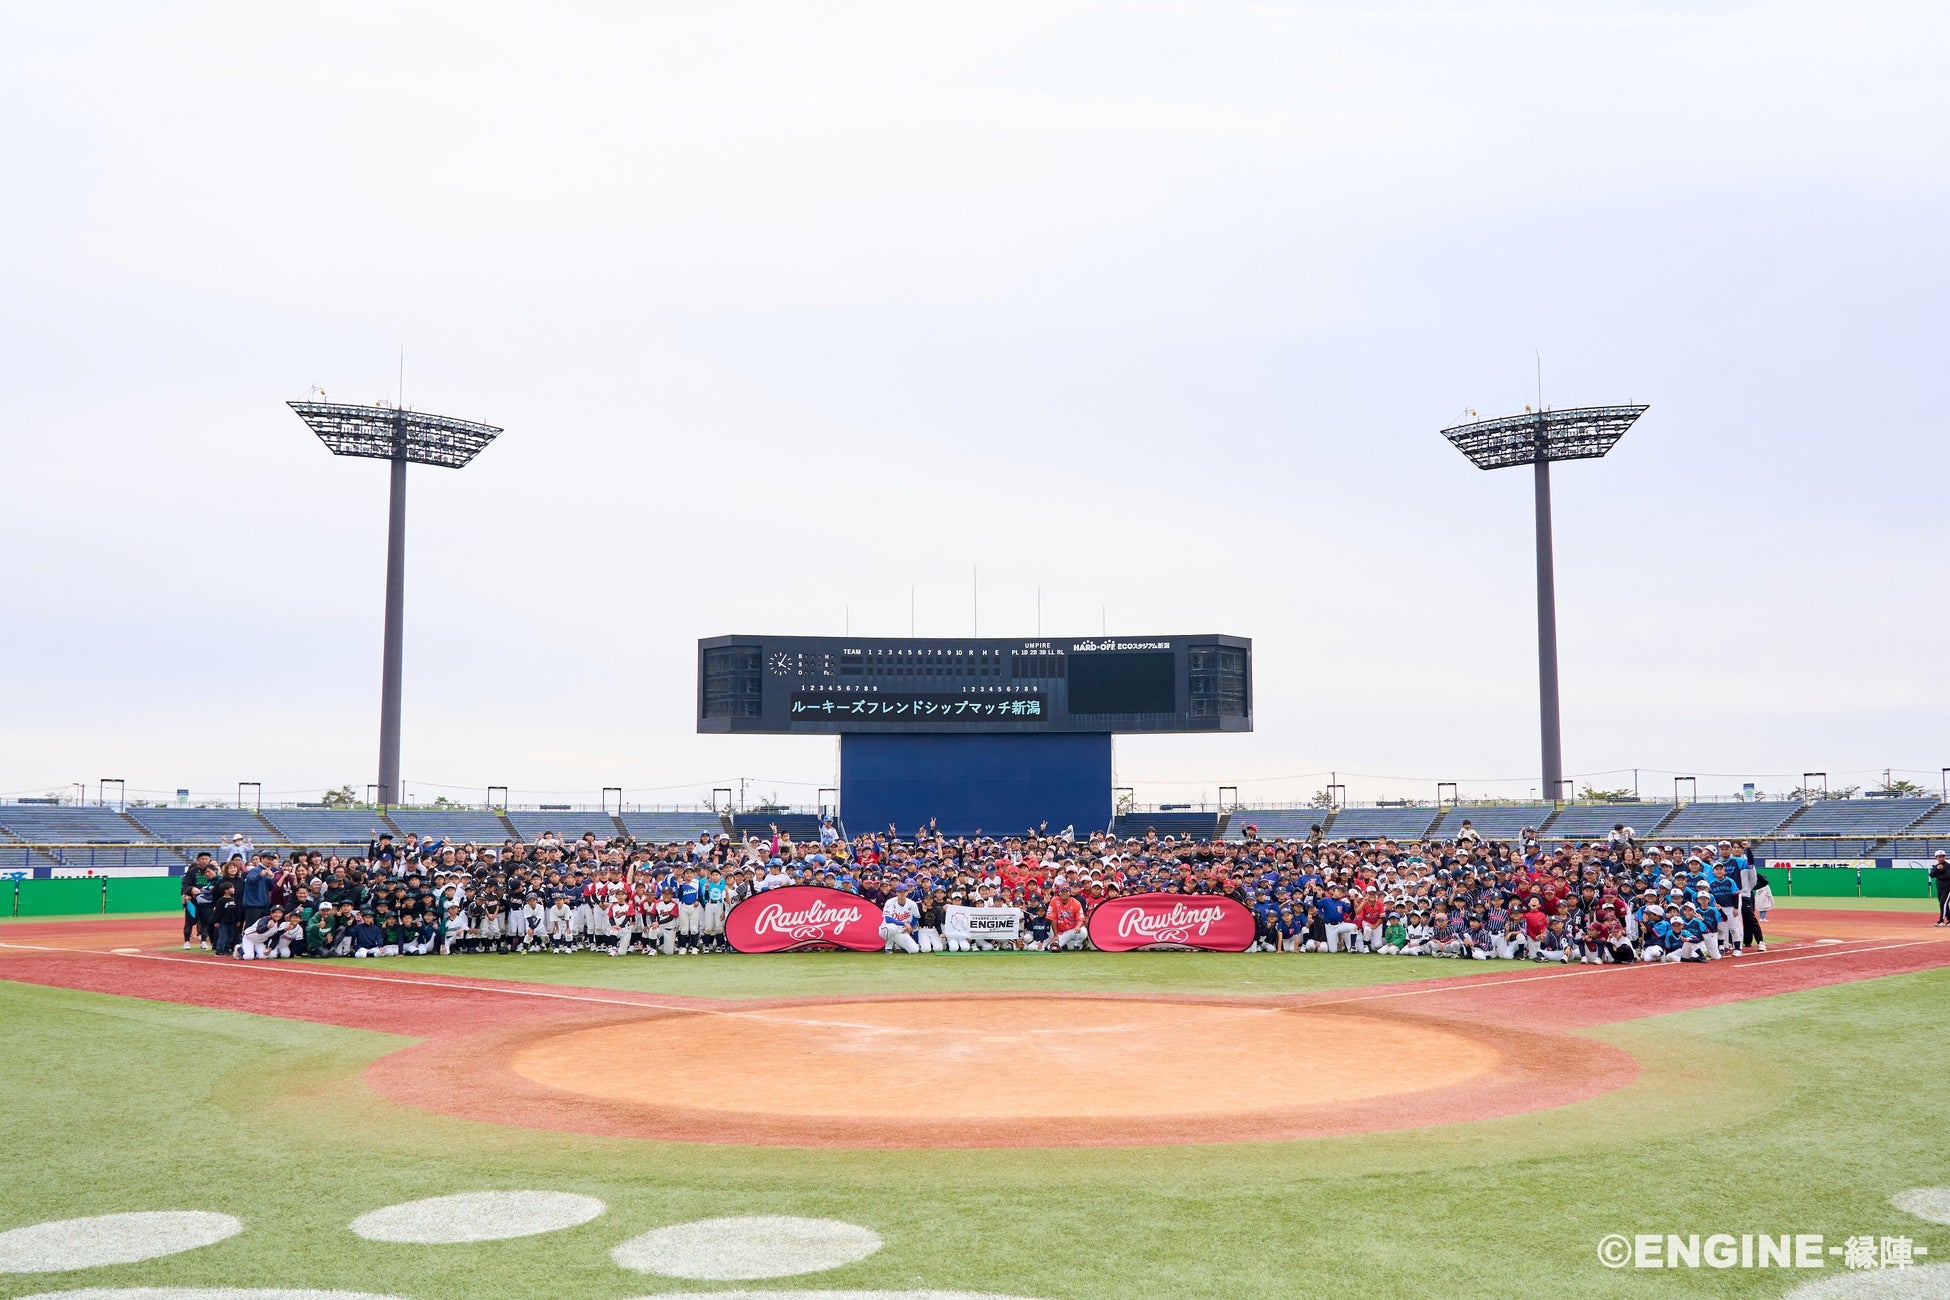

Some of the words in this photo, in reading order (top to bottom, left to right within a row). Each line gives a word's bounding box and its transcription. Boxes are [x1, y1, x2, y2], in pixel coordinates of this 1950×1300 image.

[791, 699, 1041, 715] ルーキーズフレンドシップマッチ新潟
[754, 899, 862, 935] Rawlings
[969, 920, 1015, 929] ENGINE
[1118, 902, 1225, 938] Rawlings
